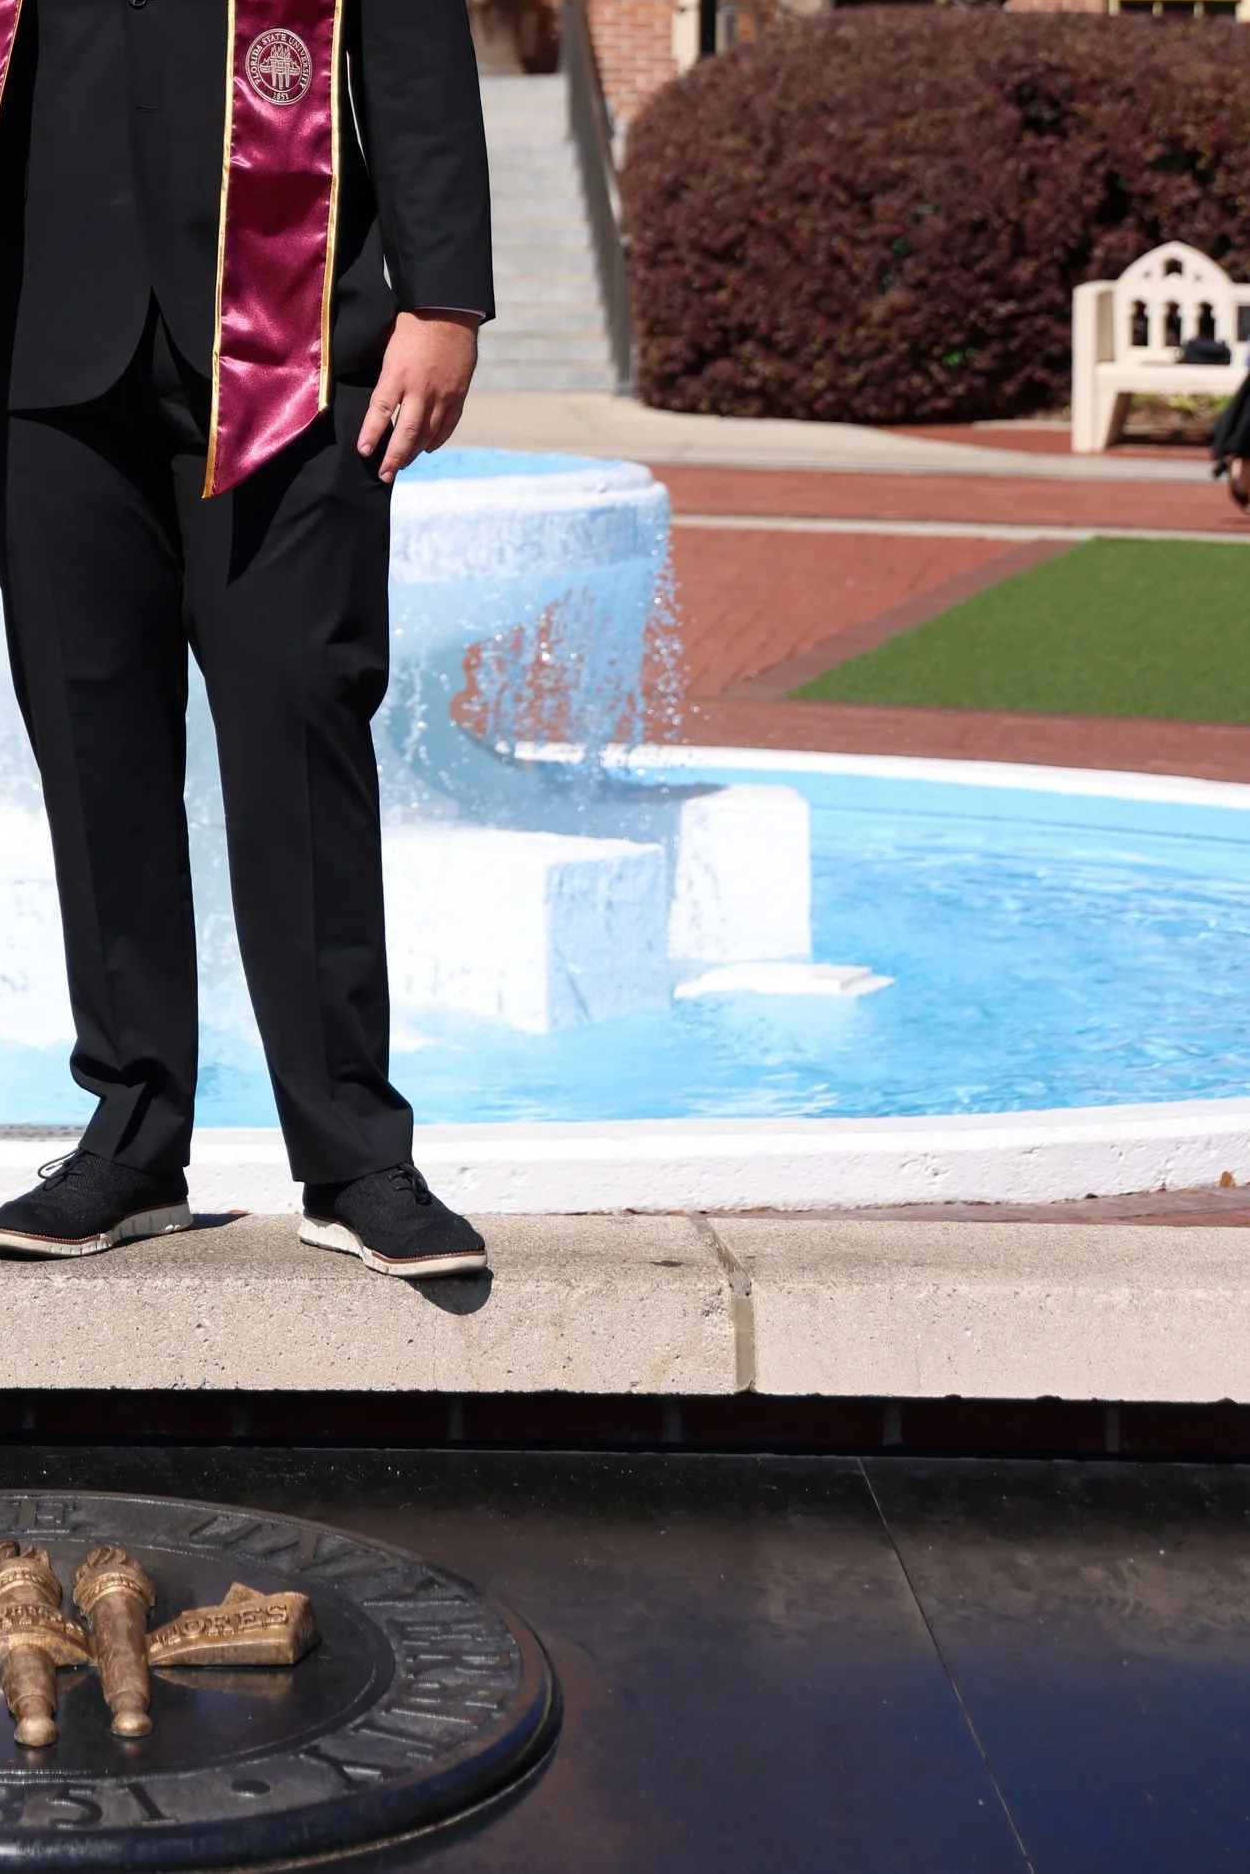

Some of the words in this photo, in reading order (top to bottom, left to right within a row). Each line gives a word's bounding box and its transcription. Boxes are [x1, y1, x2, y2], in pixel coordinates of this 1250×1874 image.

[250, 44, 263, 85] FLORIDA
[262, 33, 287, 45] STATE
[288, 37, 309, 89] UNIVERSITY
[272, 91, 289, 100] 1851
